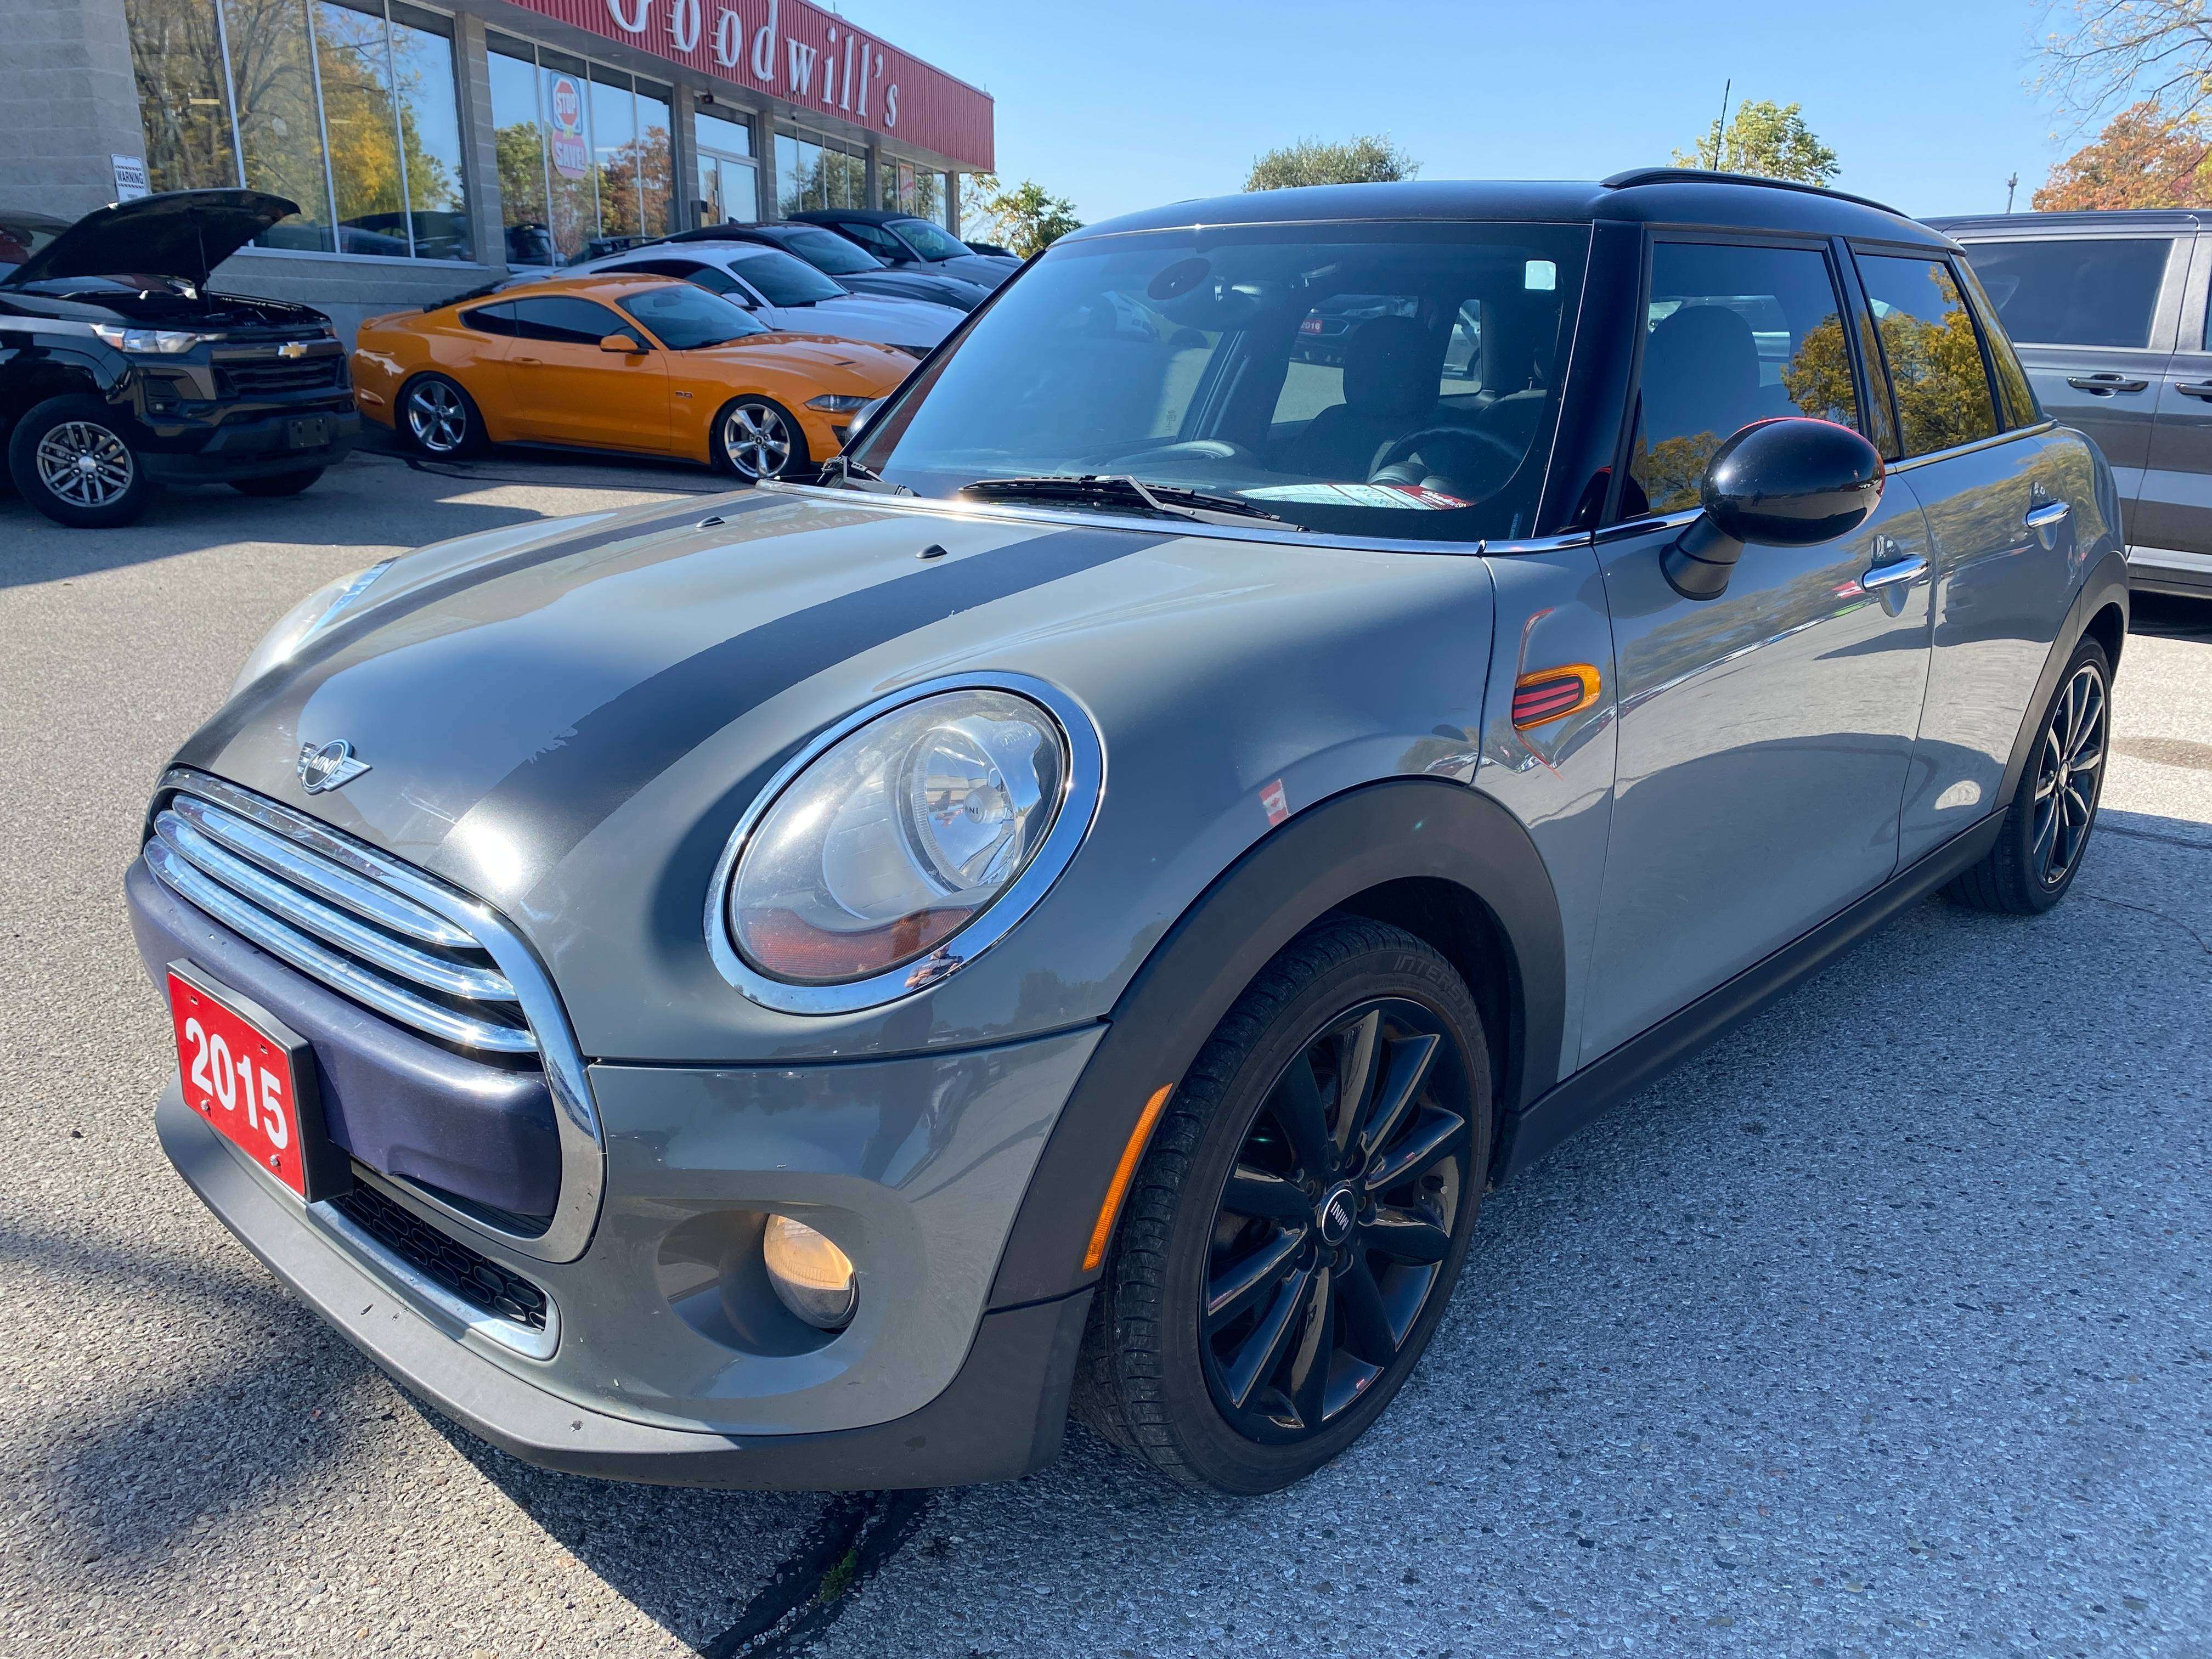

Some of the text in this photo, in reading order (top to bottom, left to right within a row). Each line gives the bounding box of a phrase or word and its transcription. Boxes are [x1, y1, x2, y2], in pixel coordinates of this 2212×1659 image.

[556, 92, 576, 114] STOP
[116, 171, 144, 184] WARNING
[309, 755, 340, 775] MINI
[185, 1018, 288, 1149] 2015
[1330, 1201, 1349, 1231] MINI
